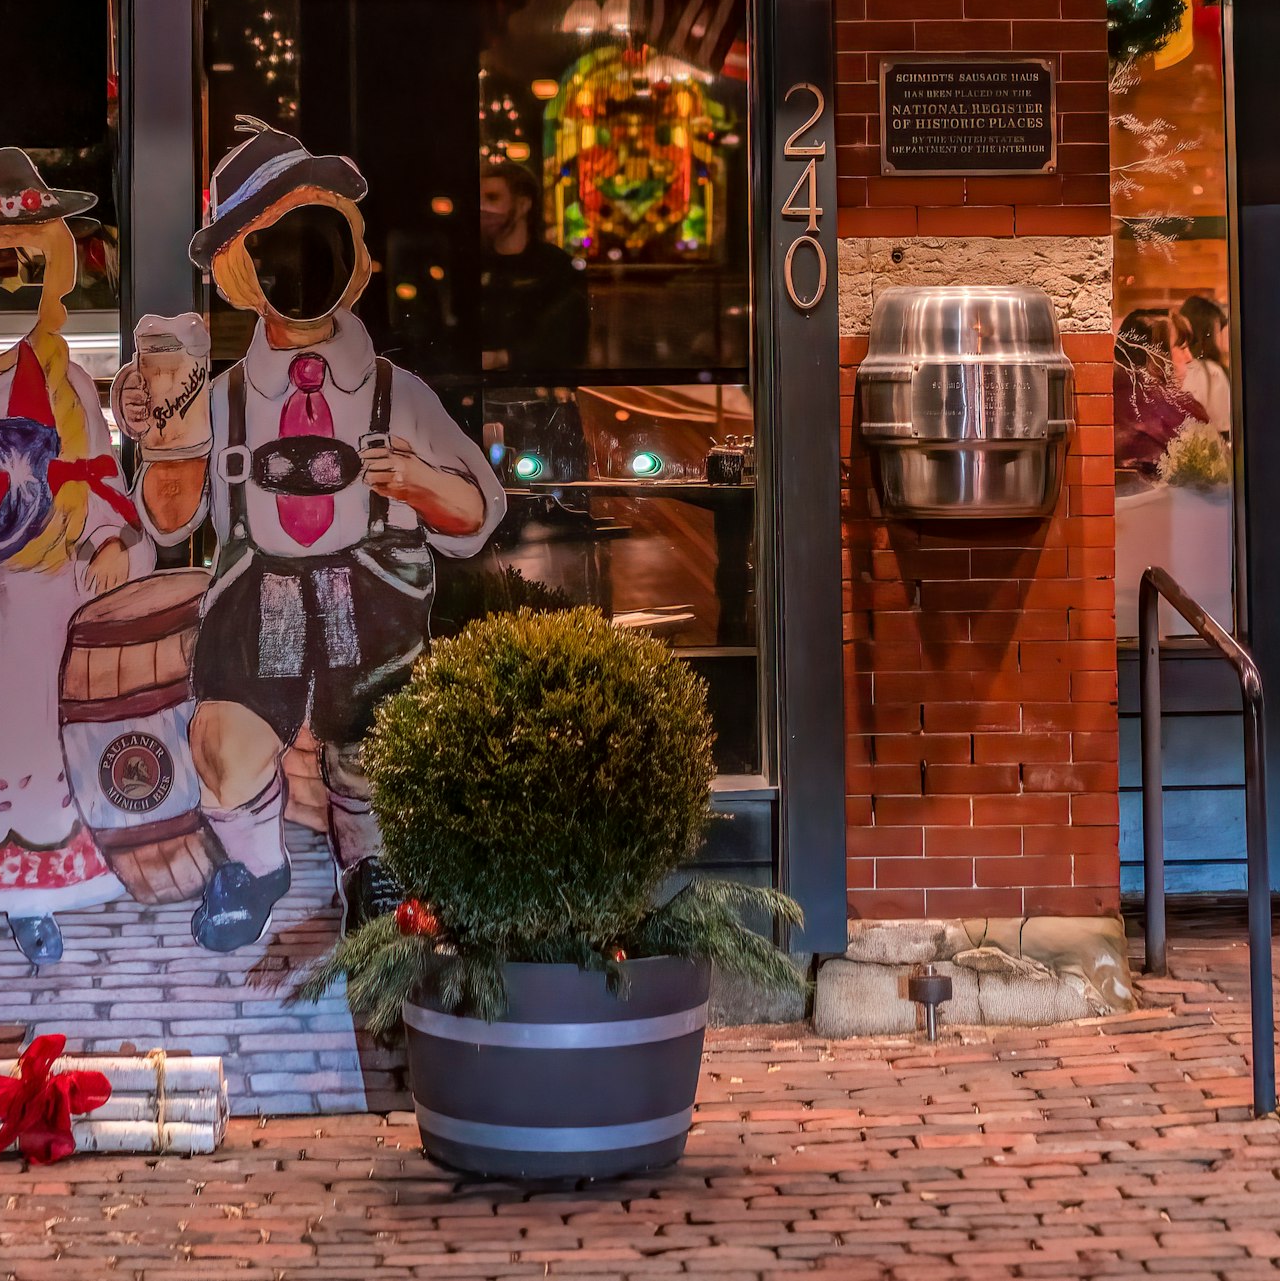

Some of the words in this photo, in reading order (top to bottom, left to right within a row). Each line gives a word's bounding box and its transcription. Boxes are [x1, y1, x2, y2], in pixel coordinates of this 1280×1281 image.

[896, 73, 954, 83] SCHMIDT'S
[958, 73, 1007, 83] SAUSAGE
[1011, 73, 1039, 82] HAUS
[926, 90, 952, 98] BEEN
[955, 90, 993, 98] PLACED
[1012, 90, 1032, 98] THE
[892, 104, 968, 115] NATIONAL
[972, 103, 1043, 114] REGISTER
[892, 119, 911, 129] OF
[916, 119, 986, 129] HISTORIC
[989, 118, 1043, 129] PLACES
[912, 136, 925, 144] BY
[950, 136, 986, 144] UNITED
[892, 146, 959, 154] DEPARTMENT
[960, 146, 974, 154] OF
[976, 145, 996, 153] THE
[998, 145, 1045, 153] INTERIOR
[781, 83, 827, 310] 240
[102, 735, 164, 769] PAULANER
[107, 786, 150, 810] MUNICH
[152, 775, 171, 802] BIER
